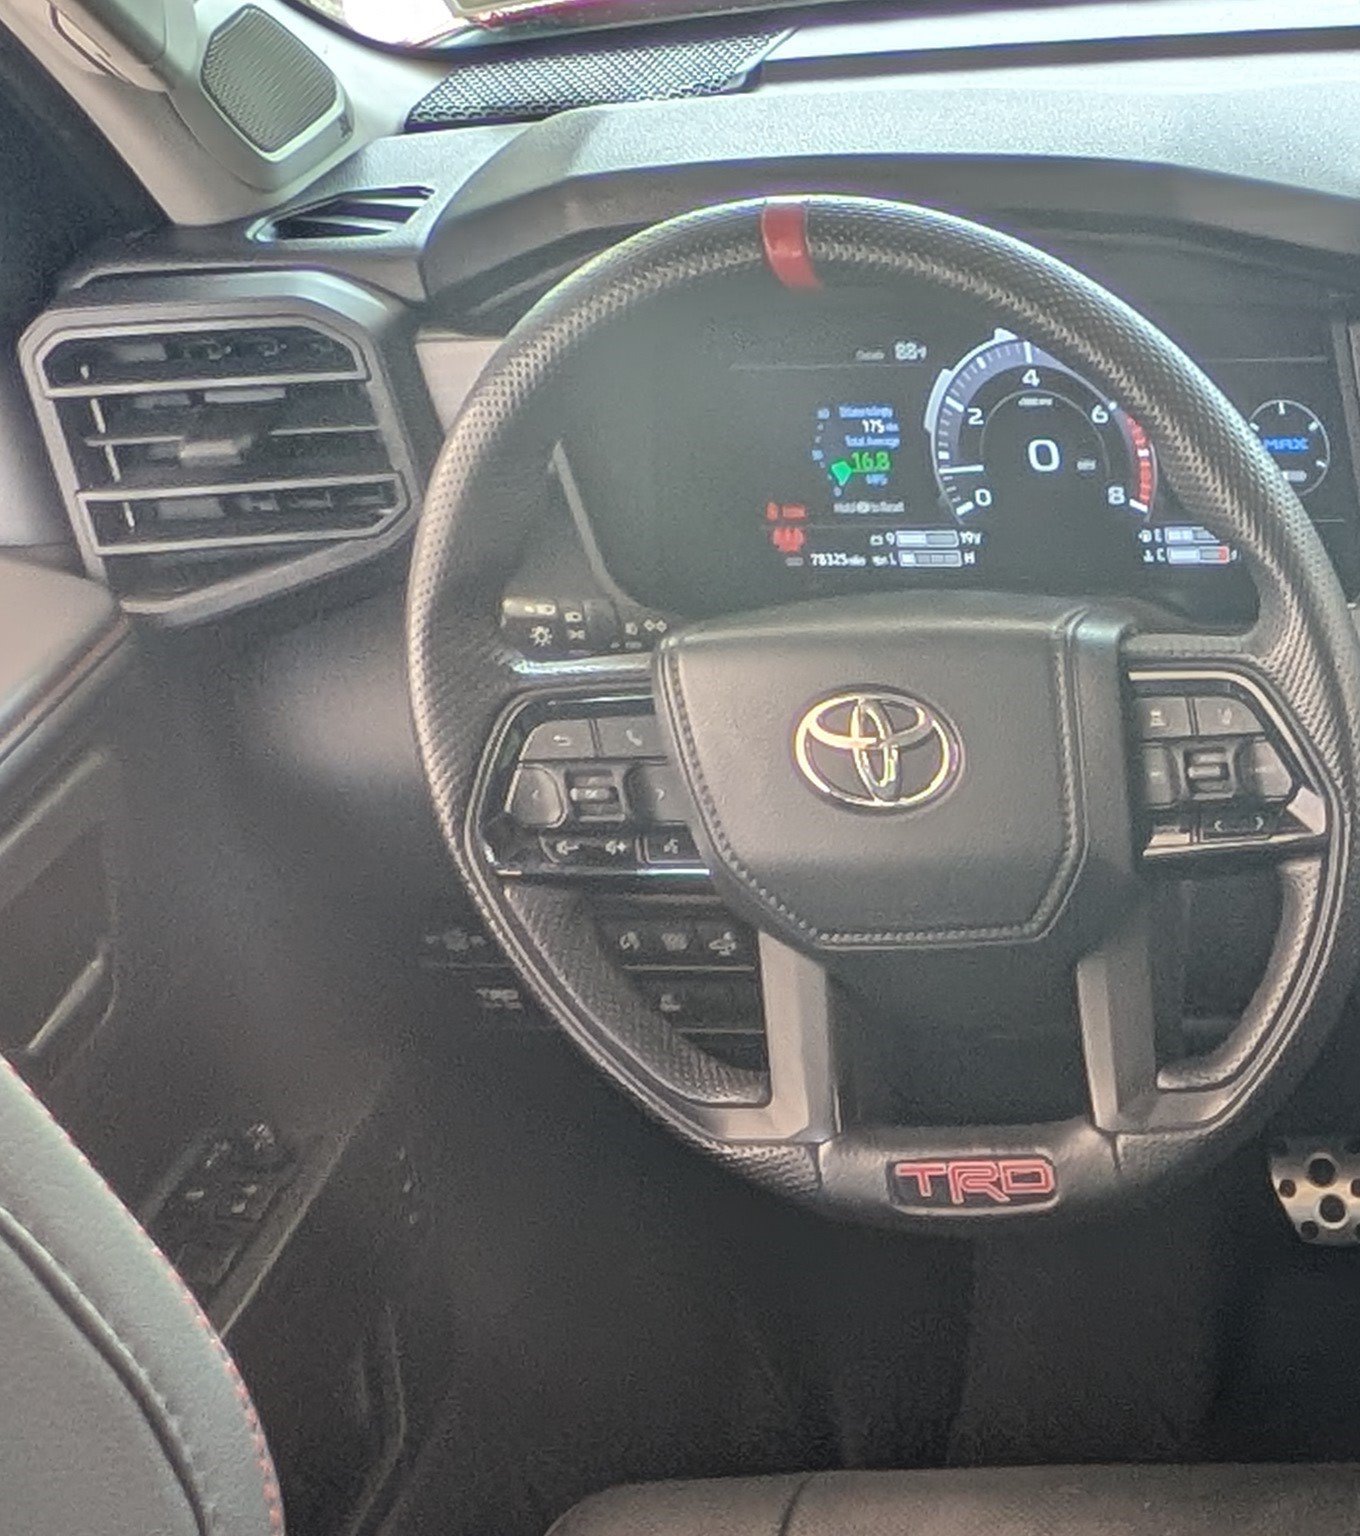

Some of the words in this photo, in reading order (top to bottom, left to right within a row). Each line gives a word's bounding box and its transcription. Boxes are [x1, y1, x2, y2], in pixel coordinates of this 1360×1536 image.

[1022, 369, 1040, 388] 4
[967, 407, 985, 425] 2
[1091, 404, 1109, 424] 6
[1262, 437, 1309, 451] MAX
[1027, 438, 1061, 473] 0
[974, 488, 993, 507] 0
[1108, 485, 1126, 505] 8
[895, 1158, 1057, 1205] TRD
